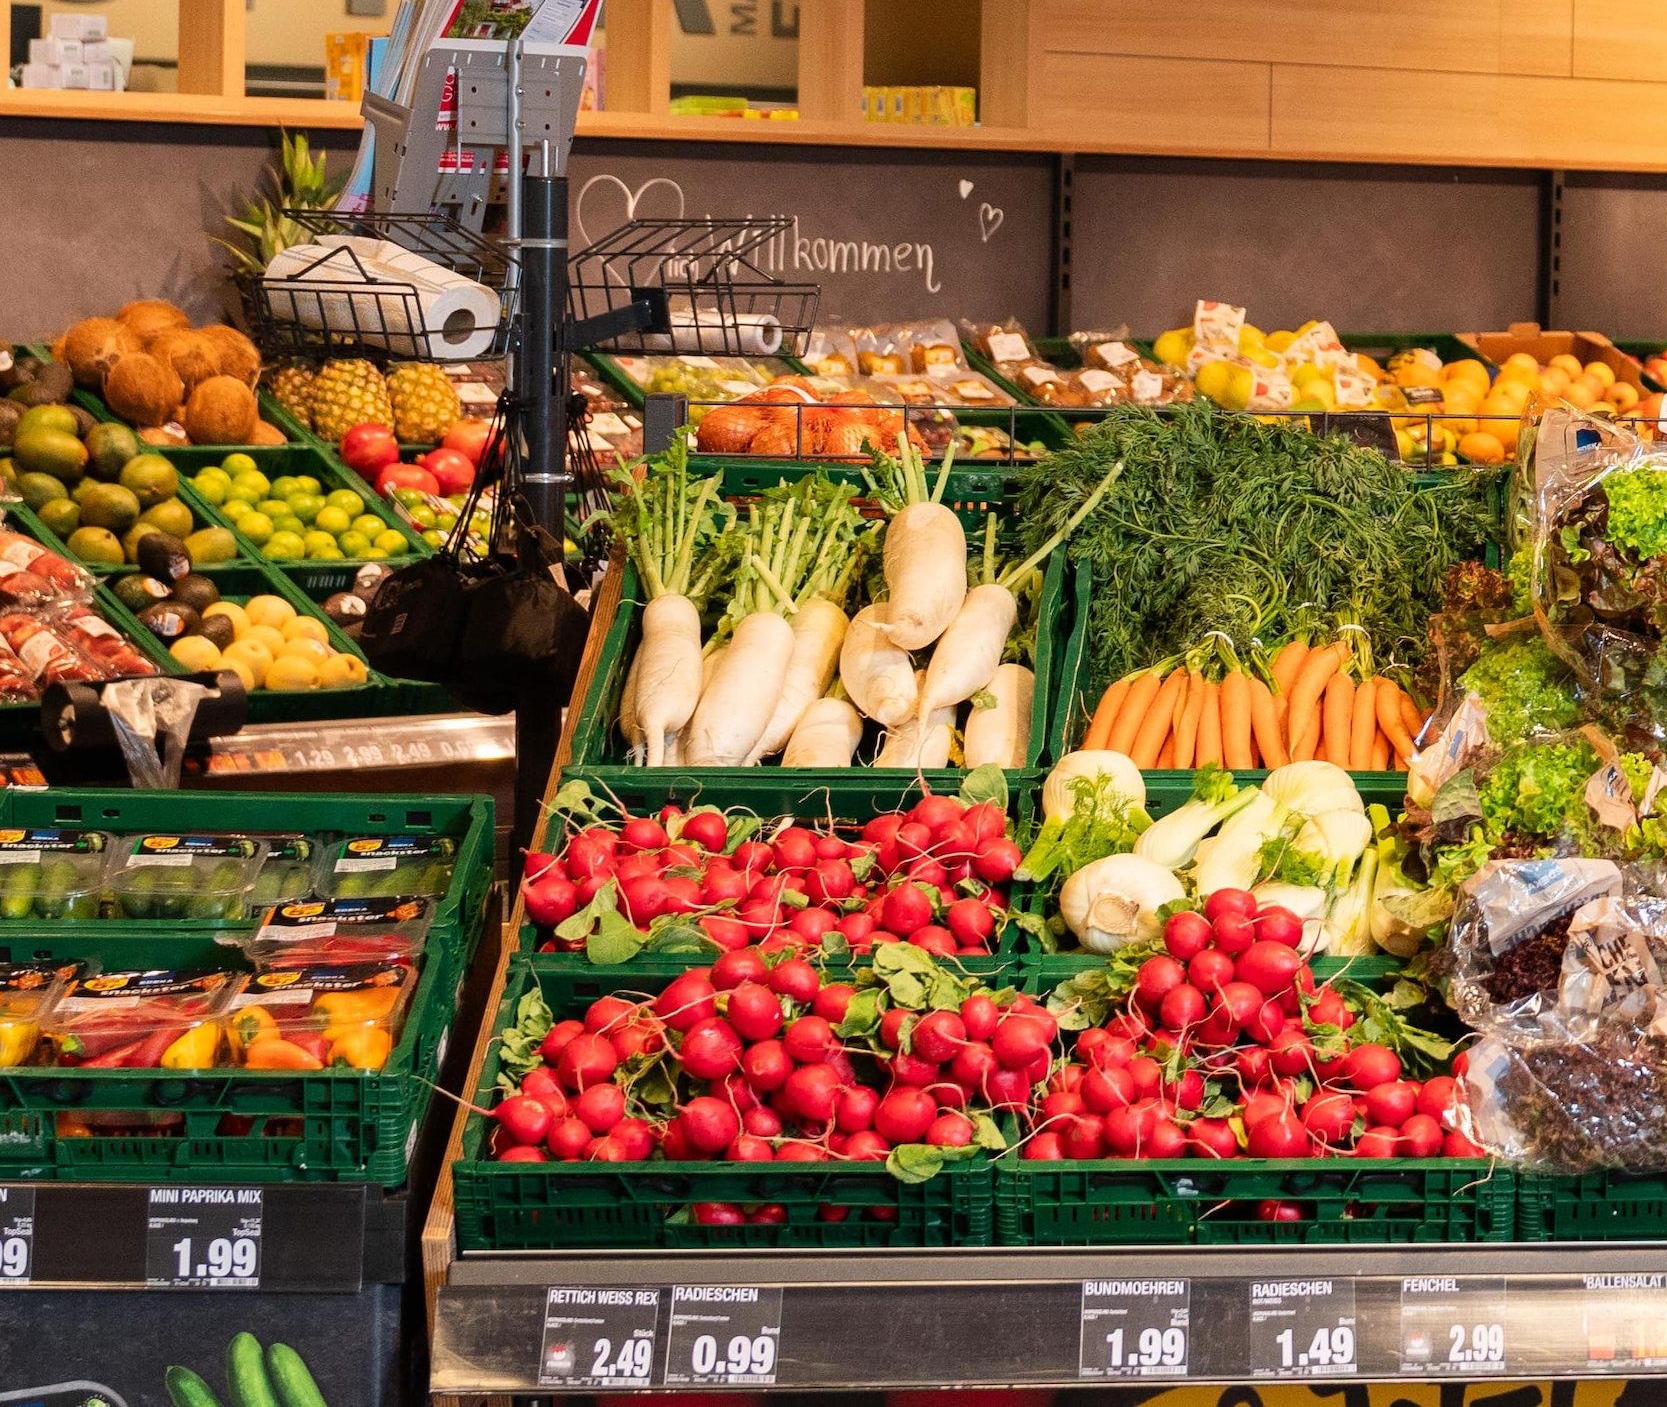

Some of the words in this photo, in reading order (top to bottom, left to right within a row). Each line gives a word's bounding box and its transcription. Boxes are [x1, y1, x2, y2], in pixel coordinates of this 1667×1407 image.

[704, 213, 941, 294] Willkommen
[155, 846, 227, 856] snackster
[360, 849, 429, 858] snackster
[298, 912, 385, 924] snackster
[273, 980, 363, 991] snackster
[150, 1189, 179, 1203] MINI
[182, 1189, 235, 1203] PAPRIKA
[238, 1189, 261, 1203] MIX
[232, 1227, 261, 1237] TopSeal
[173, 1238, 256, 1276] 1.99
[1085, 1281, 1184, 1295] BUNDMOEHREN
[1253, 1281, 1332, 1297] RADIESCHEN
[1403, 1278, 1459, 1292] FENCHEL
[1587, 1274, 1662, 1289] BALLENSALAT
[550, 1290, 597, 1304] RETTICH
[599, 1291, 633, 1305] WEISS
[635, 1291, 658, 1305] REX
[675, 1287, 759, 1302] RADIESCHEN
[1106, 1328, 1185, 1366] 1.99
[1276, 1327, 1354, 1367] 1.49
[1449, 1325, 1504, 1362] 2.99
[591, 1338, 651, 1377] 2.49
[692, 1335, 775, 1374] 0.99
